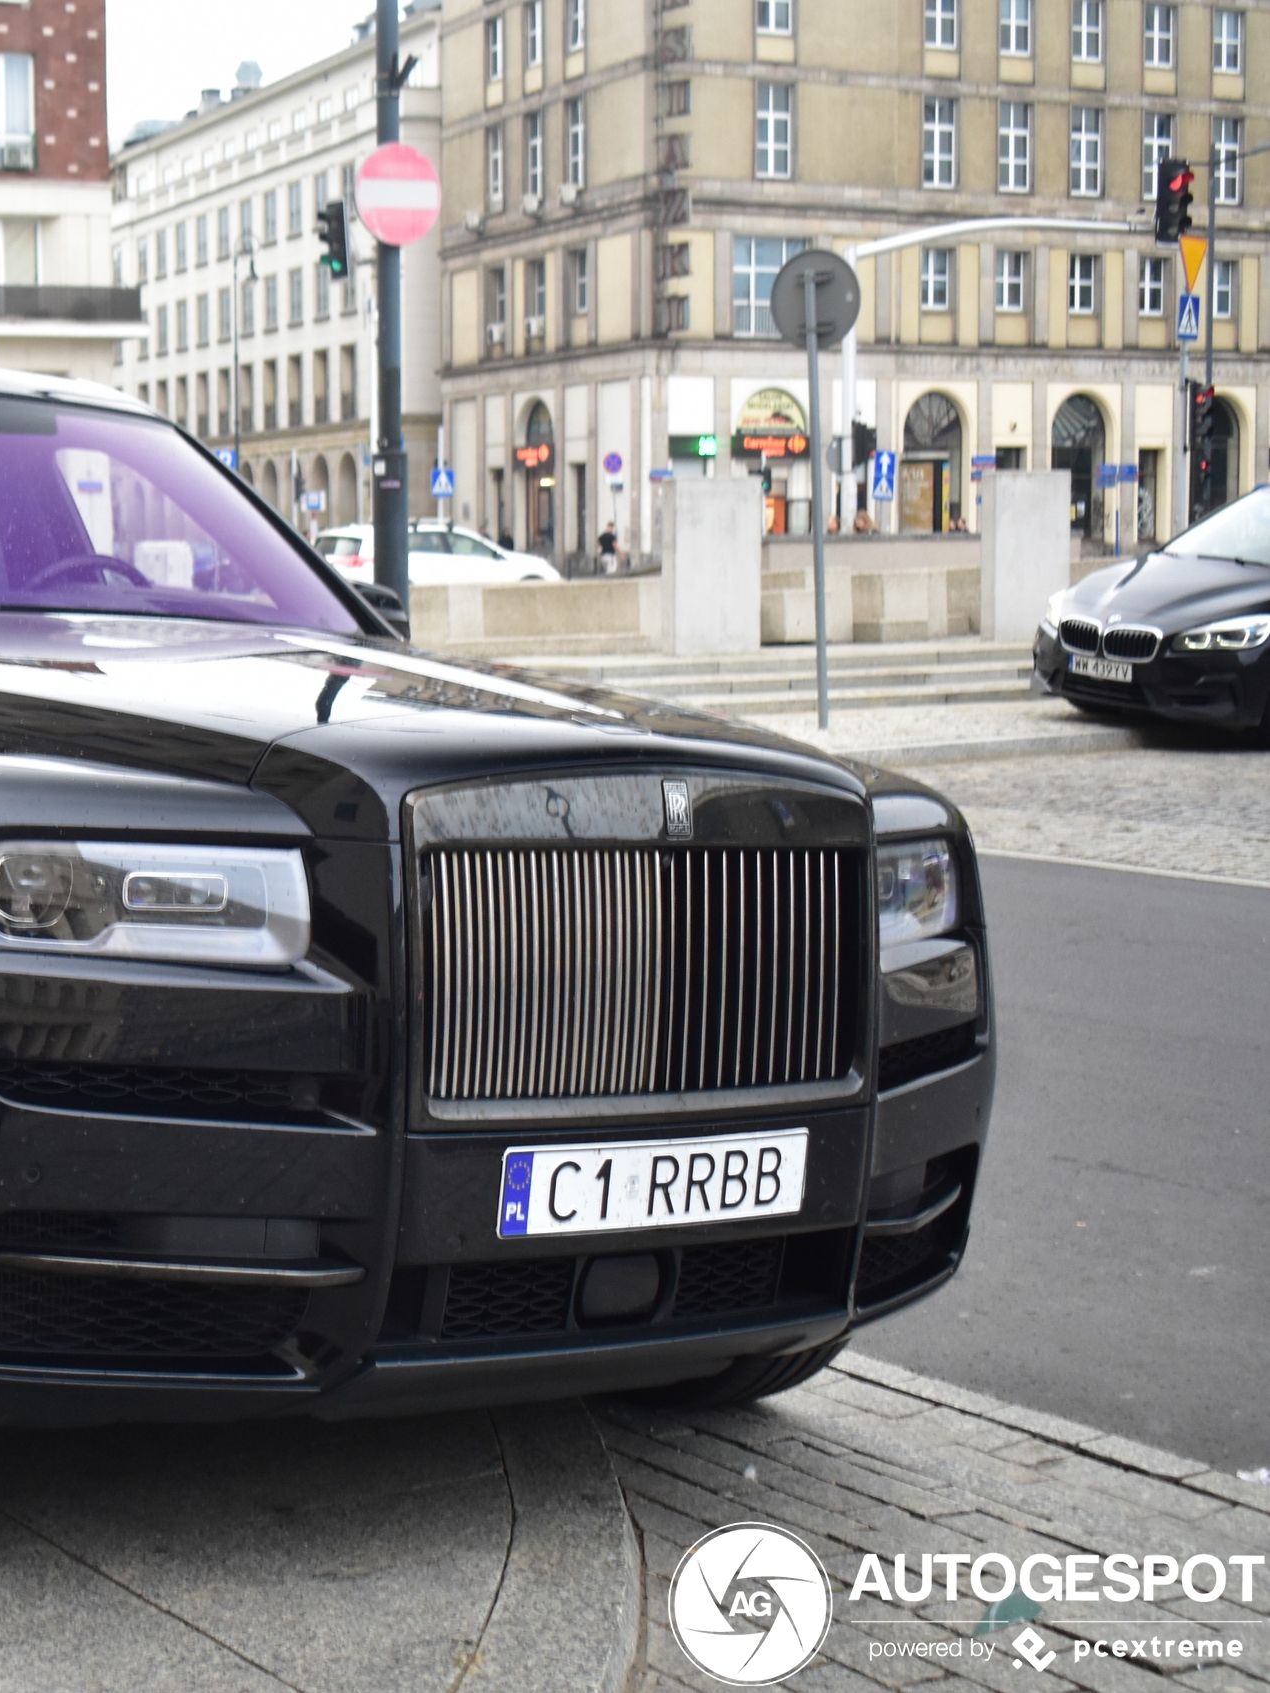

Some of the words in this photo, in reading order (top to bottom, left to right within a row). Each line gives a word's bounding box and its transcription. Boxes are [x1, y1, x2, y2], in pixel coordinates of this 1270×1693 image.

[548, 1158, 613, 1222] C1
[647, 1146, 782, 1216] RRBB
[505, 1202, 525, 1222] PL
